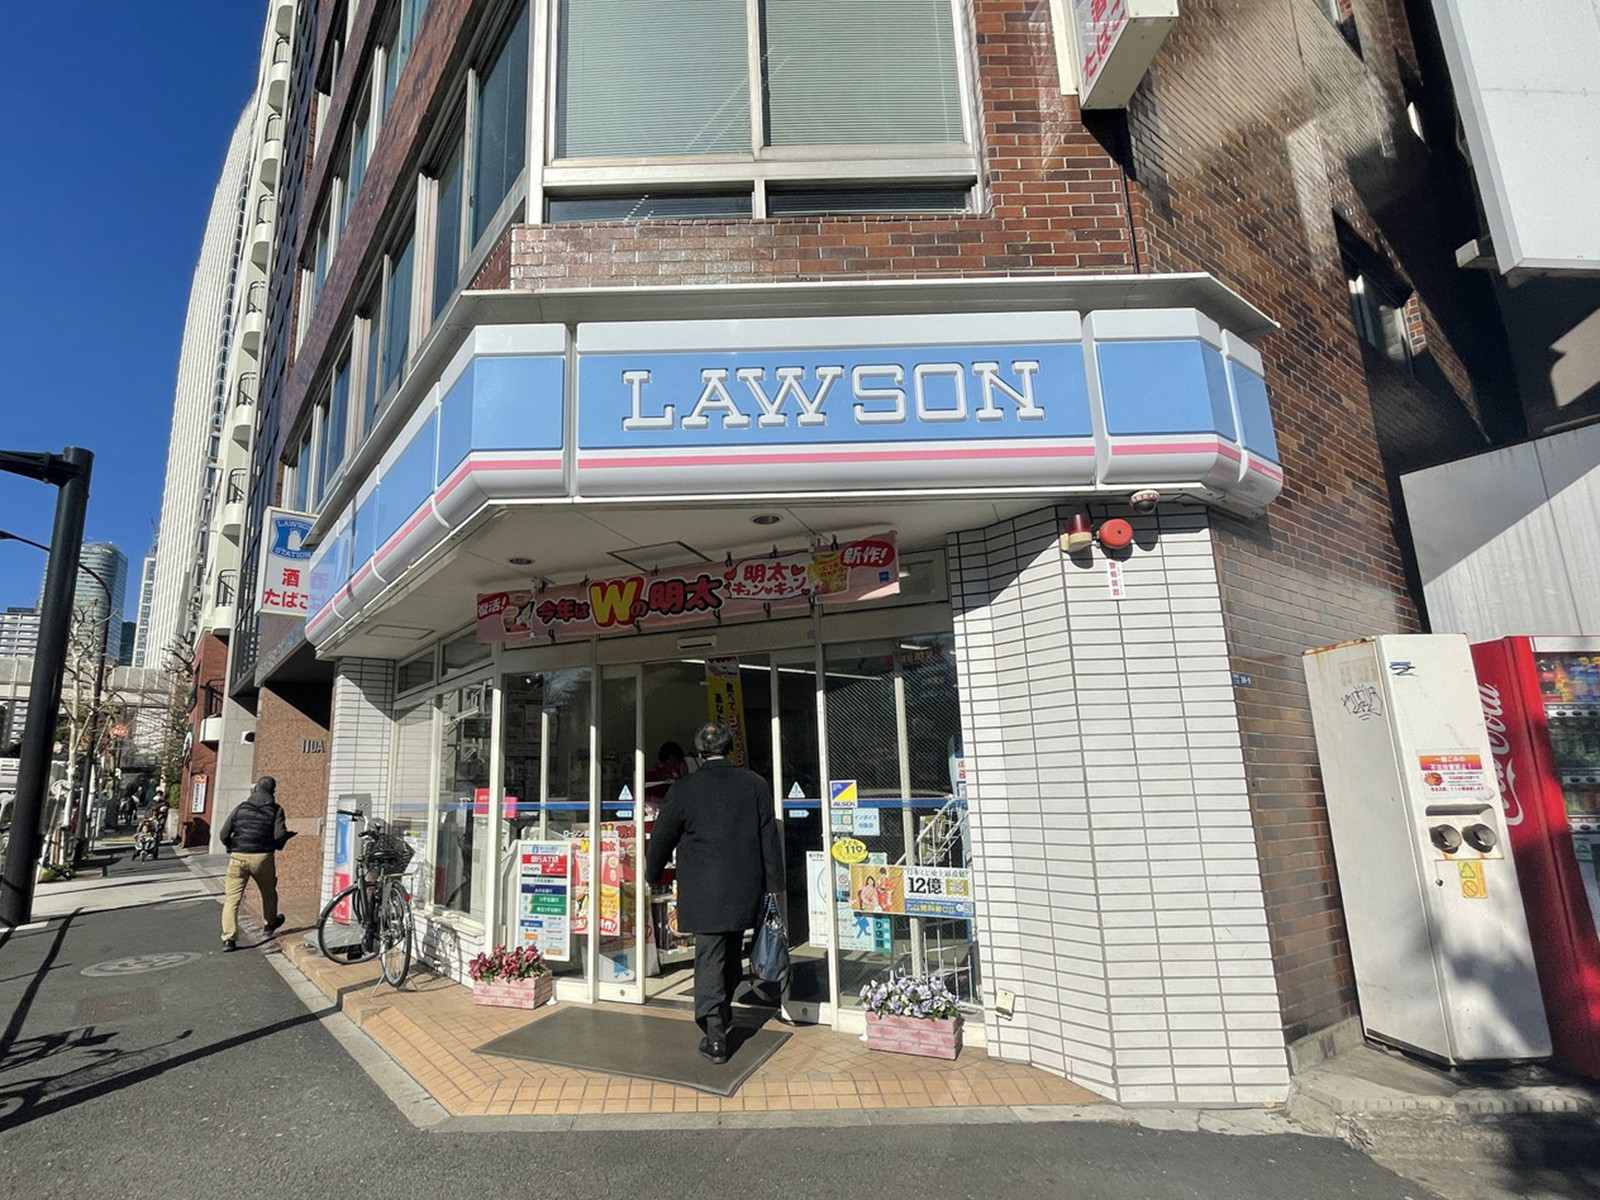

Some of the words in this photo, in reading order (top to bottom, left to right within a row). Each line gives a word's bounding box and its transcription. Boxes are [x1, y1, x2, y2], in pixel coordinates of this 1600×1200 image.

[622, 361, 1046, 431] LAWSON
[282, 567, 300, 587] 酒
[744, 562, 789, 584] 明太
[264, 588, 308, 610] たばこ
